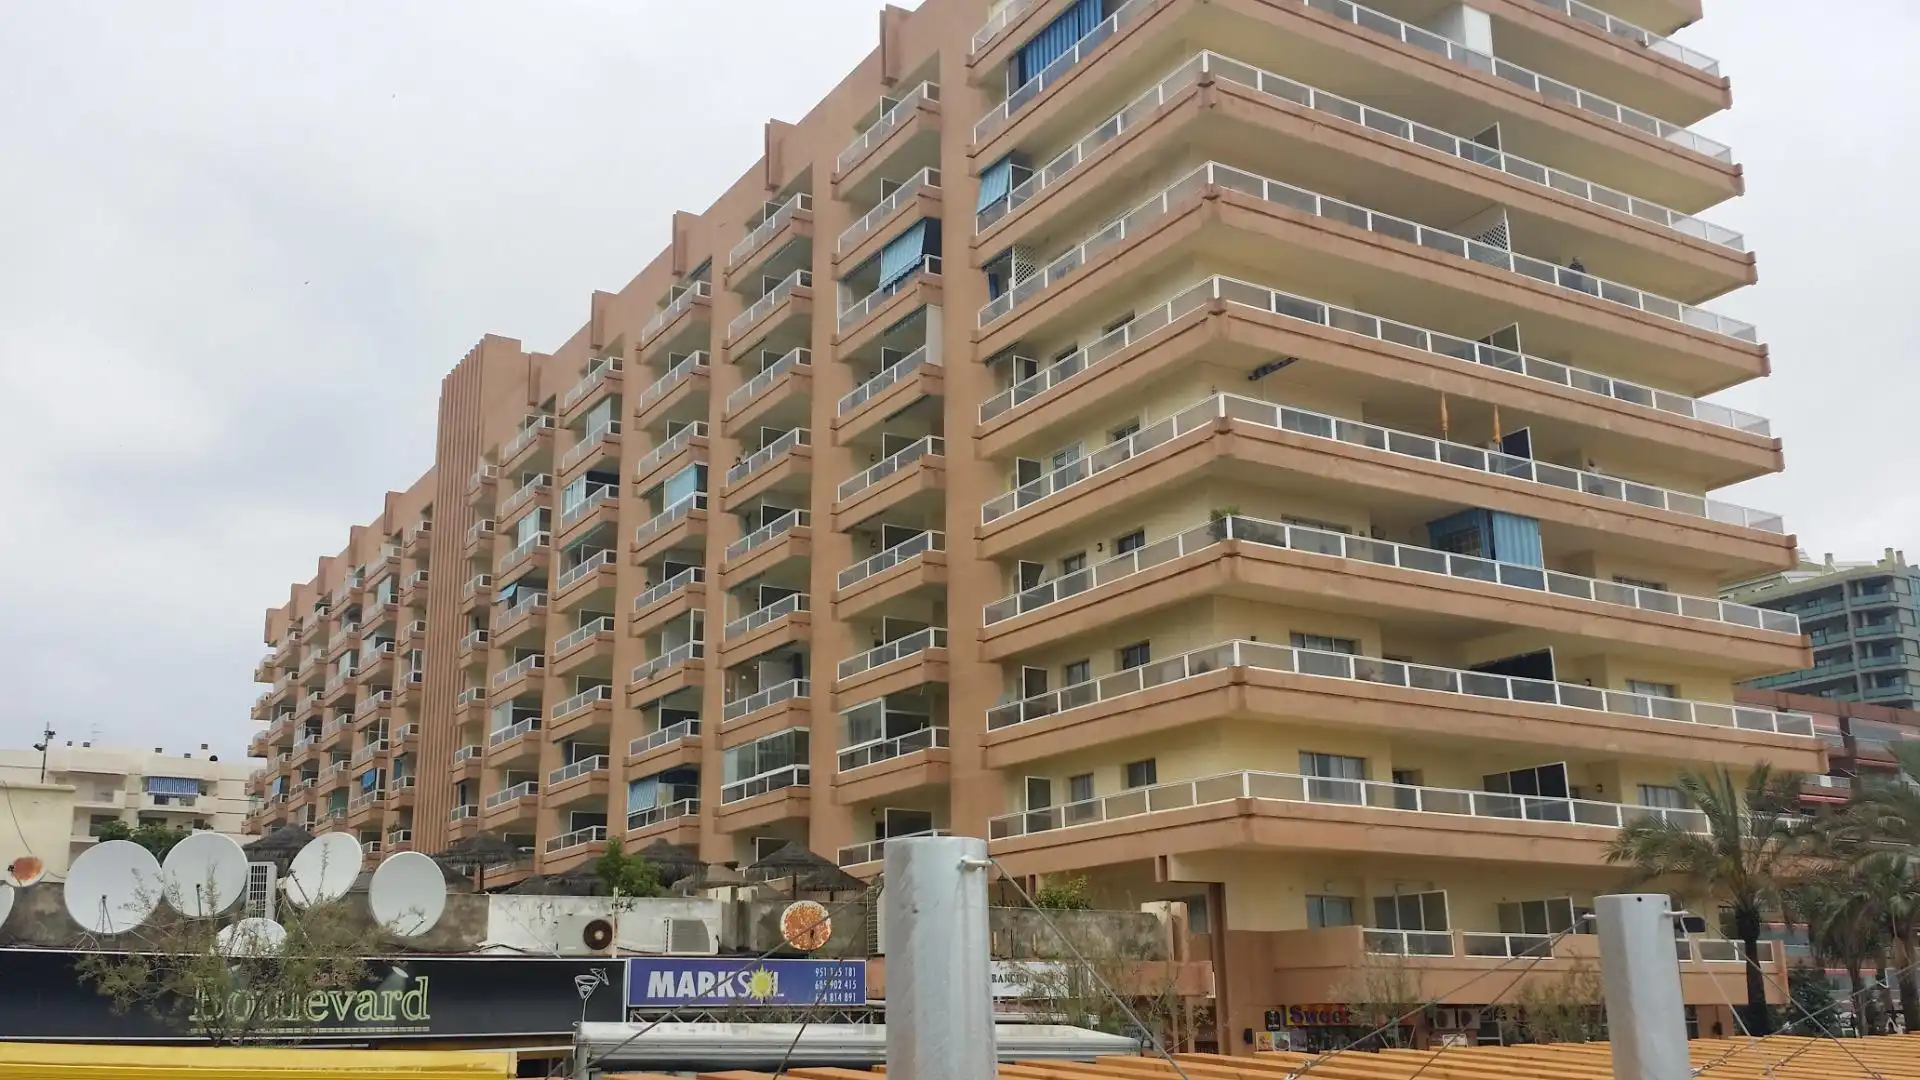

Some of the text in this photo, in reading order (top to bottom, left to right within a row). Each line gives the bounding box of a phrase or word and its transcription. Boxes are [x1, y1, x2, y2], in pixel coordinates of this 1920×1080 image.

[815, 967, 827, 977] 951
[845, 967, 856, 977] 181
[647, 967, 785, 1001] MARKSOL
[844, 979, 857, 990] 415
